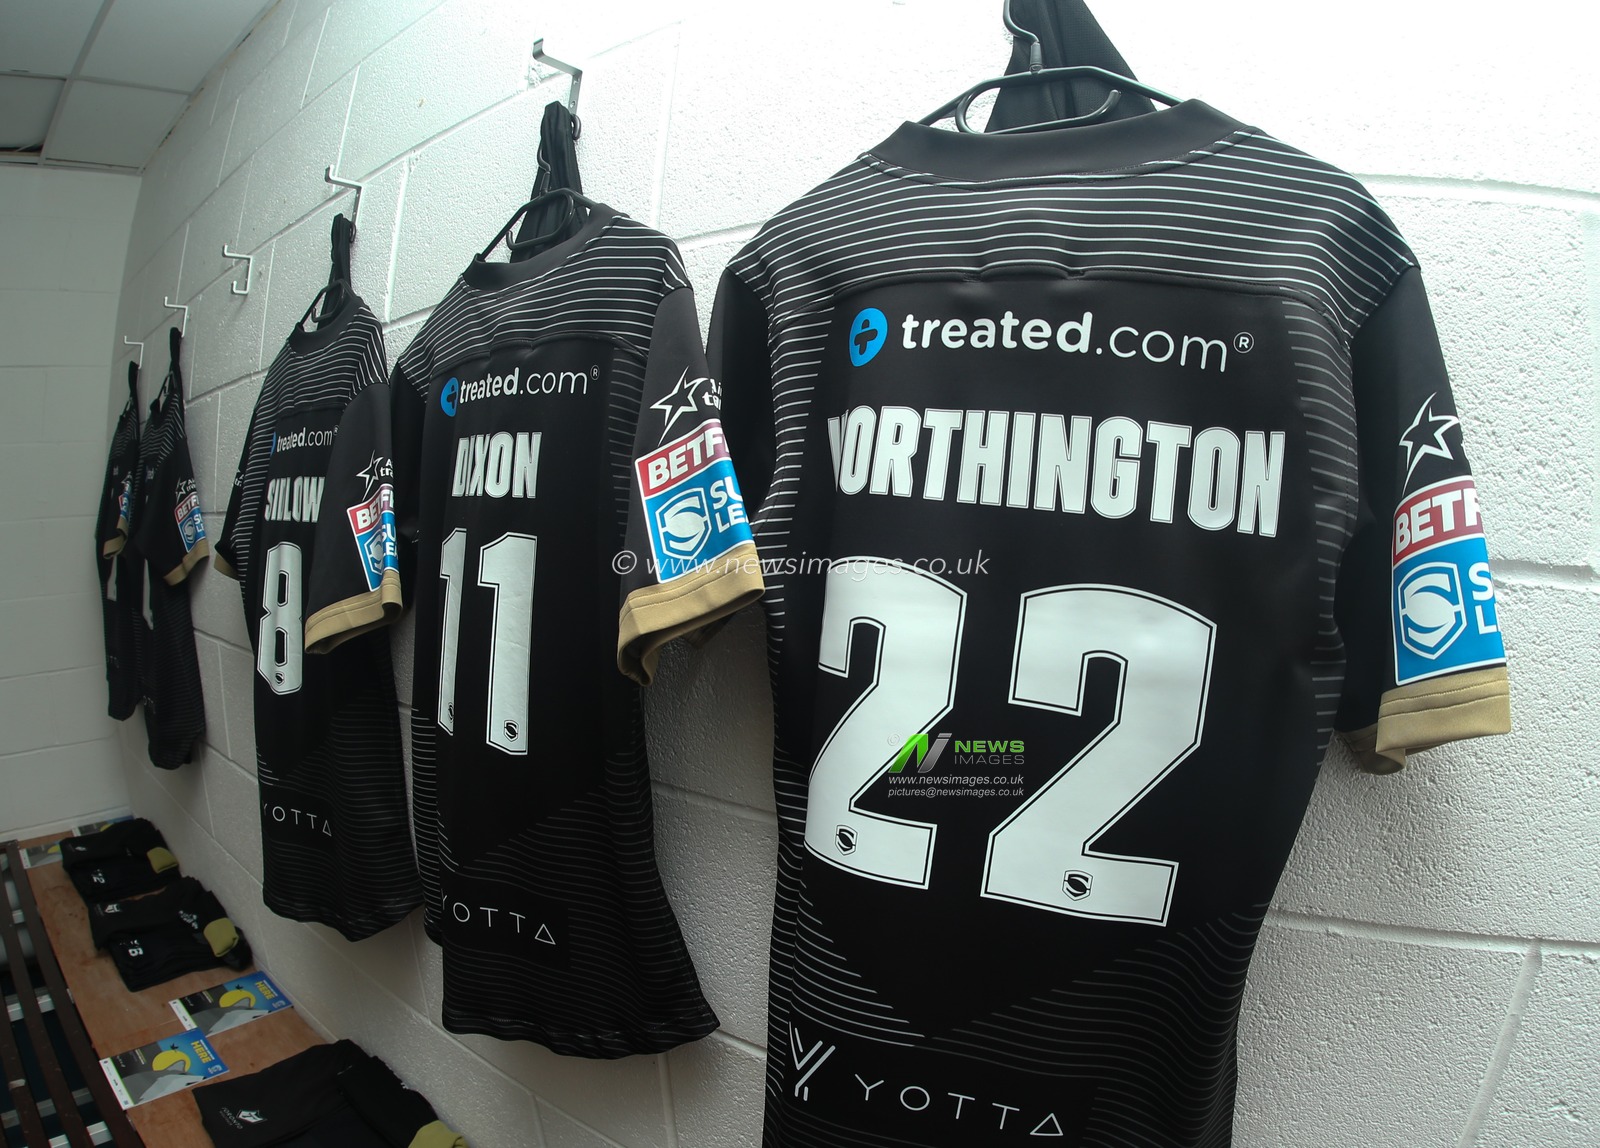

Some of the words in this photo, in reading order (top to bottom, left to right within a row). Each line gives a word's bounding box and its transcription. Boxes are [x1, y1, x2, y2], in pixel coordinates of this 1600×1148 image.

[452, 431, 542, 498] DIXON
[715, 503, 750, 533] LE
[257, 541, 302, 694] 8
[437, 527, 538, 756] 11
[803, 555, 1217, 927] 22
[190, 1041, 212, 1064] HERE
